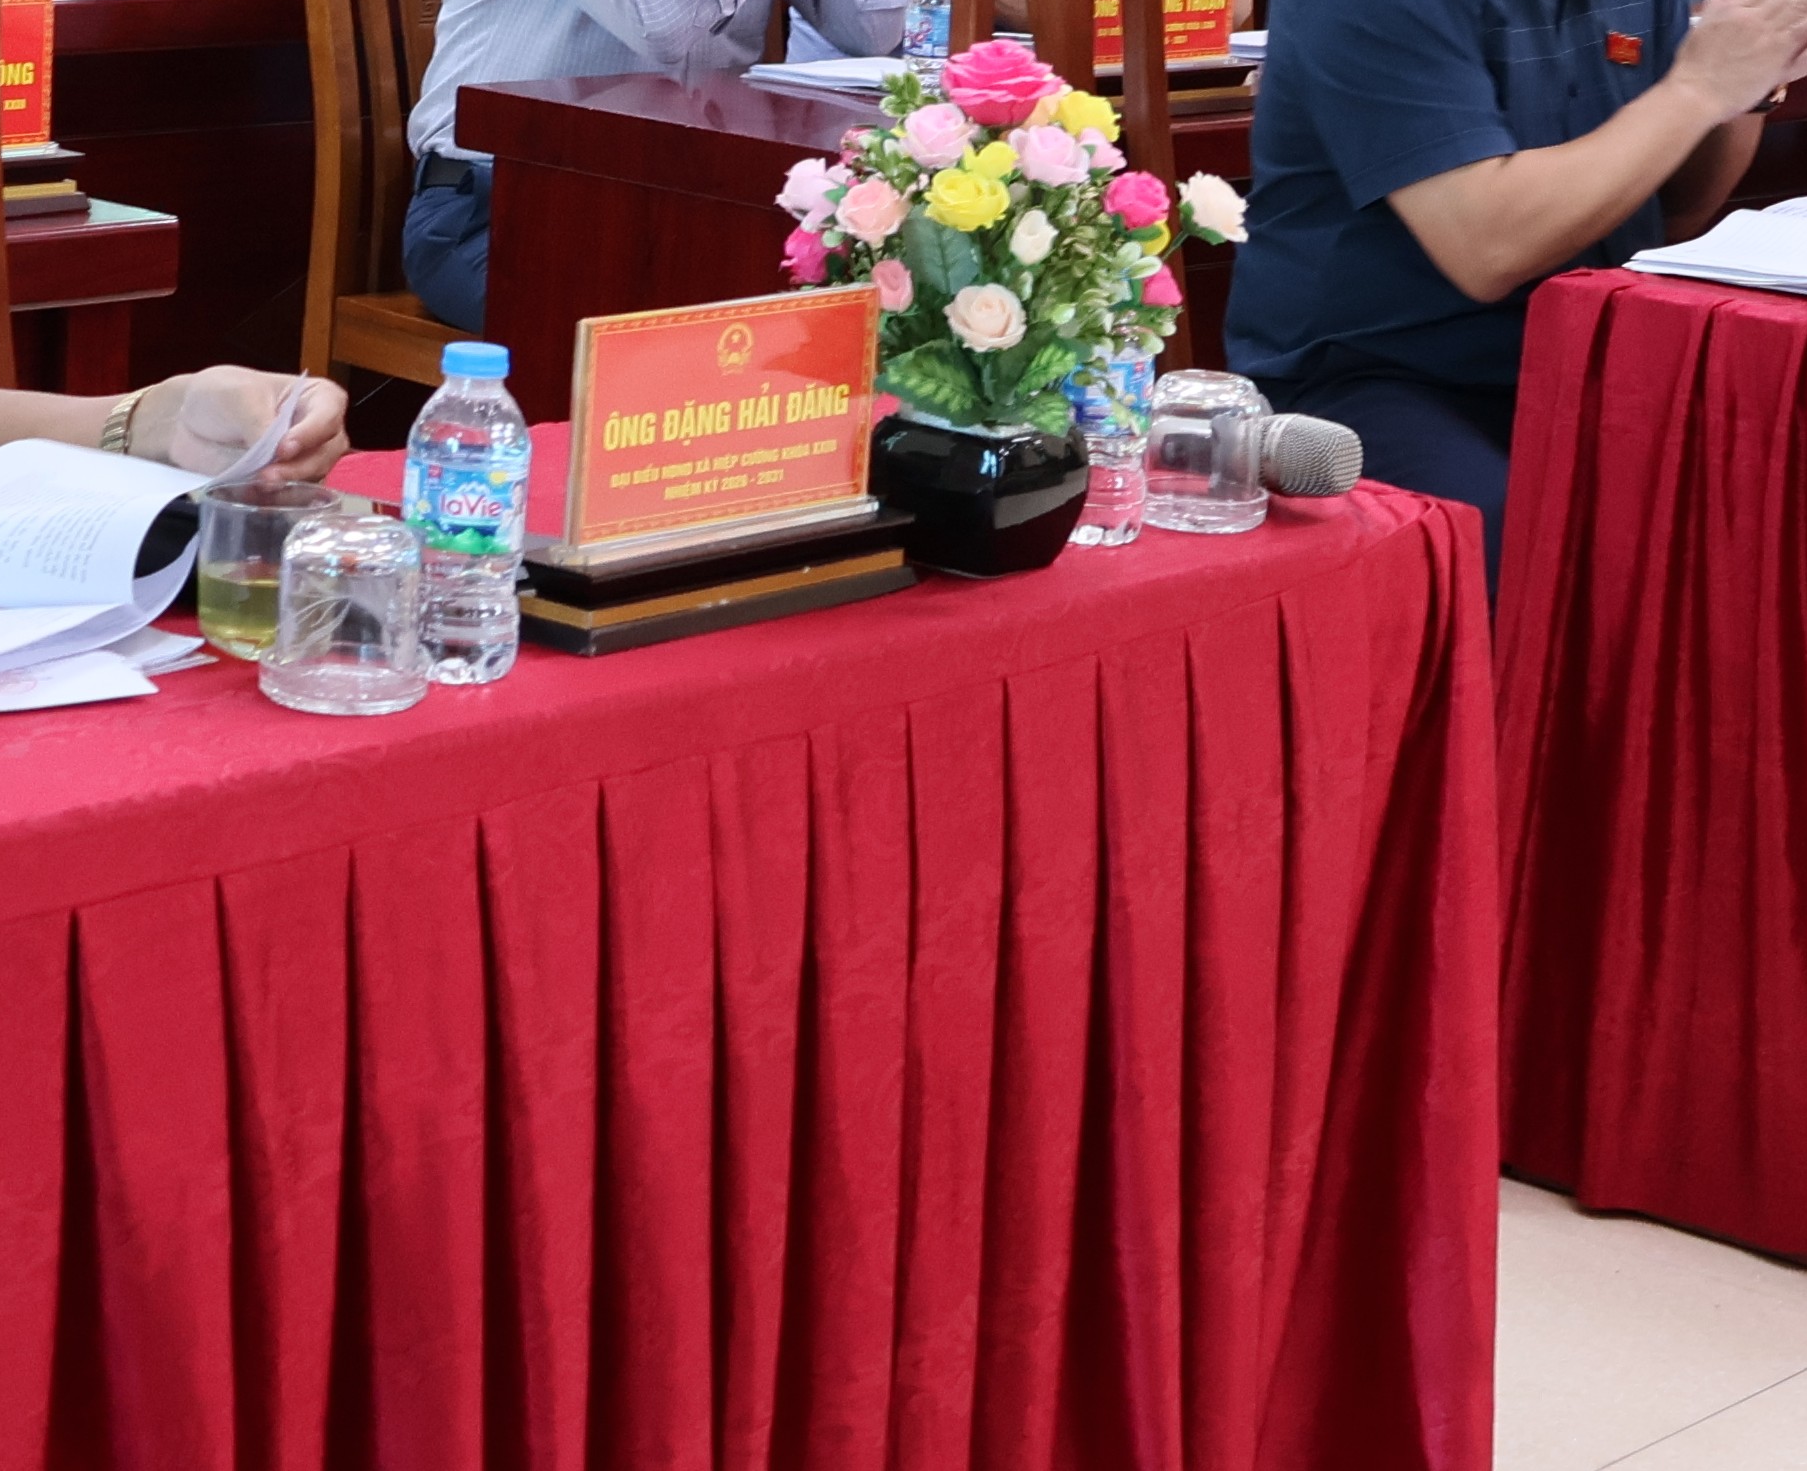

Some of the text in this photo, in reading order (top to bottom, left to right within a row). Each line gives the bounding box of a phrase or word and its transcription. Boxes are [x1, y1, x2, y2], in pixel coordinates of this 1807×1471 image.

[603, 381, 850, 452] ÔNG ĐẶNG HẢI ĐĂNG
[440, 494, 502, 517] laVie
